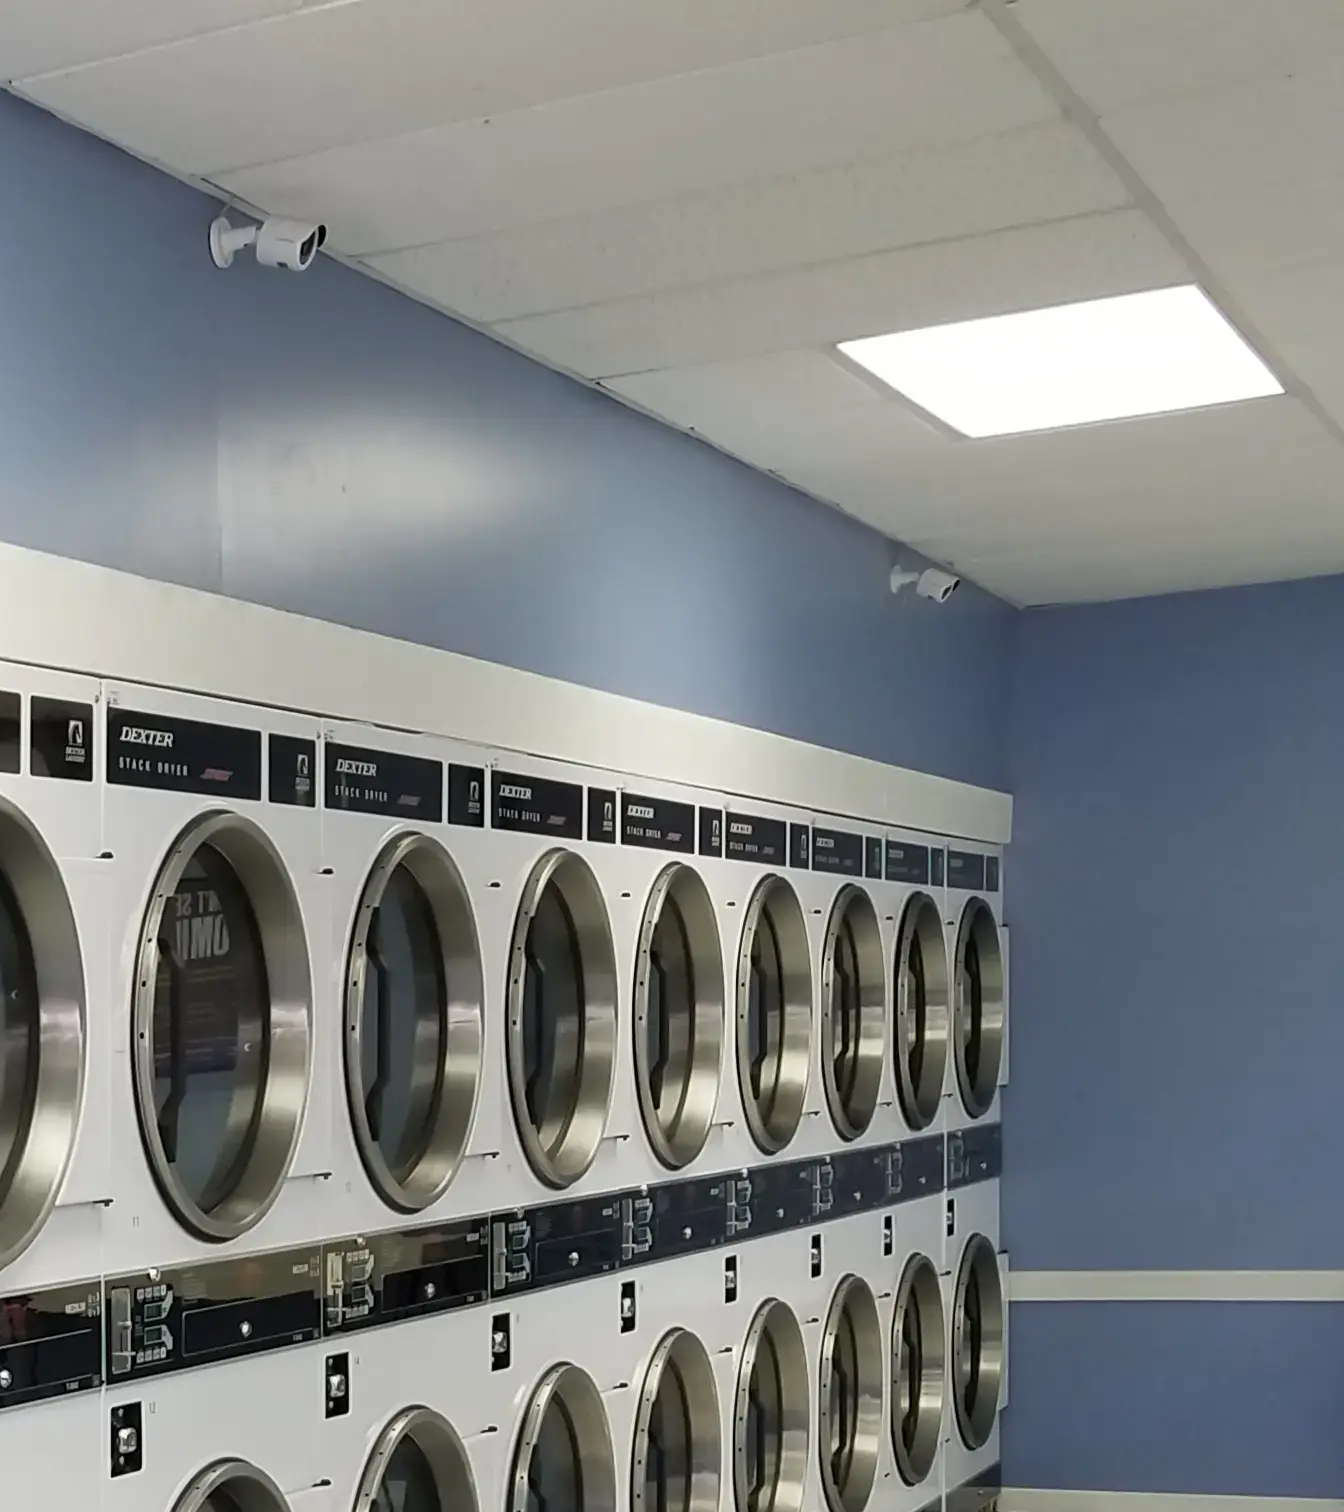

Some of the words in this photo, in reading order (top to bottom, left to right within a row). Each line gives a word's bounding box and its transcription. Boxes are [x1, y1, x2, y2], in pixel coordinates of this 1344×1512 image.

[119, 726, 174, 748] DEXTER
[118, 756, 151, 772] STACK
[157, 761, 188, 777] DRYER
[335, 758, 377, 777] DEXTER
